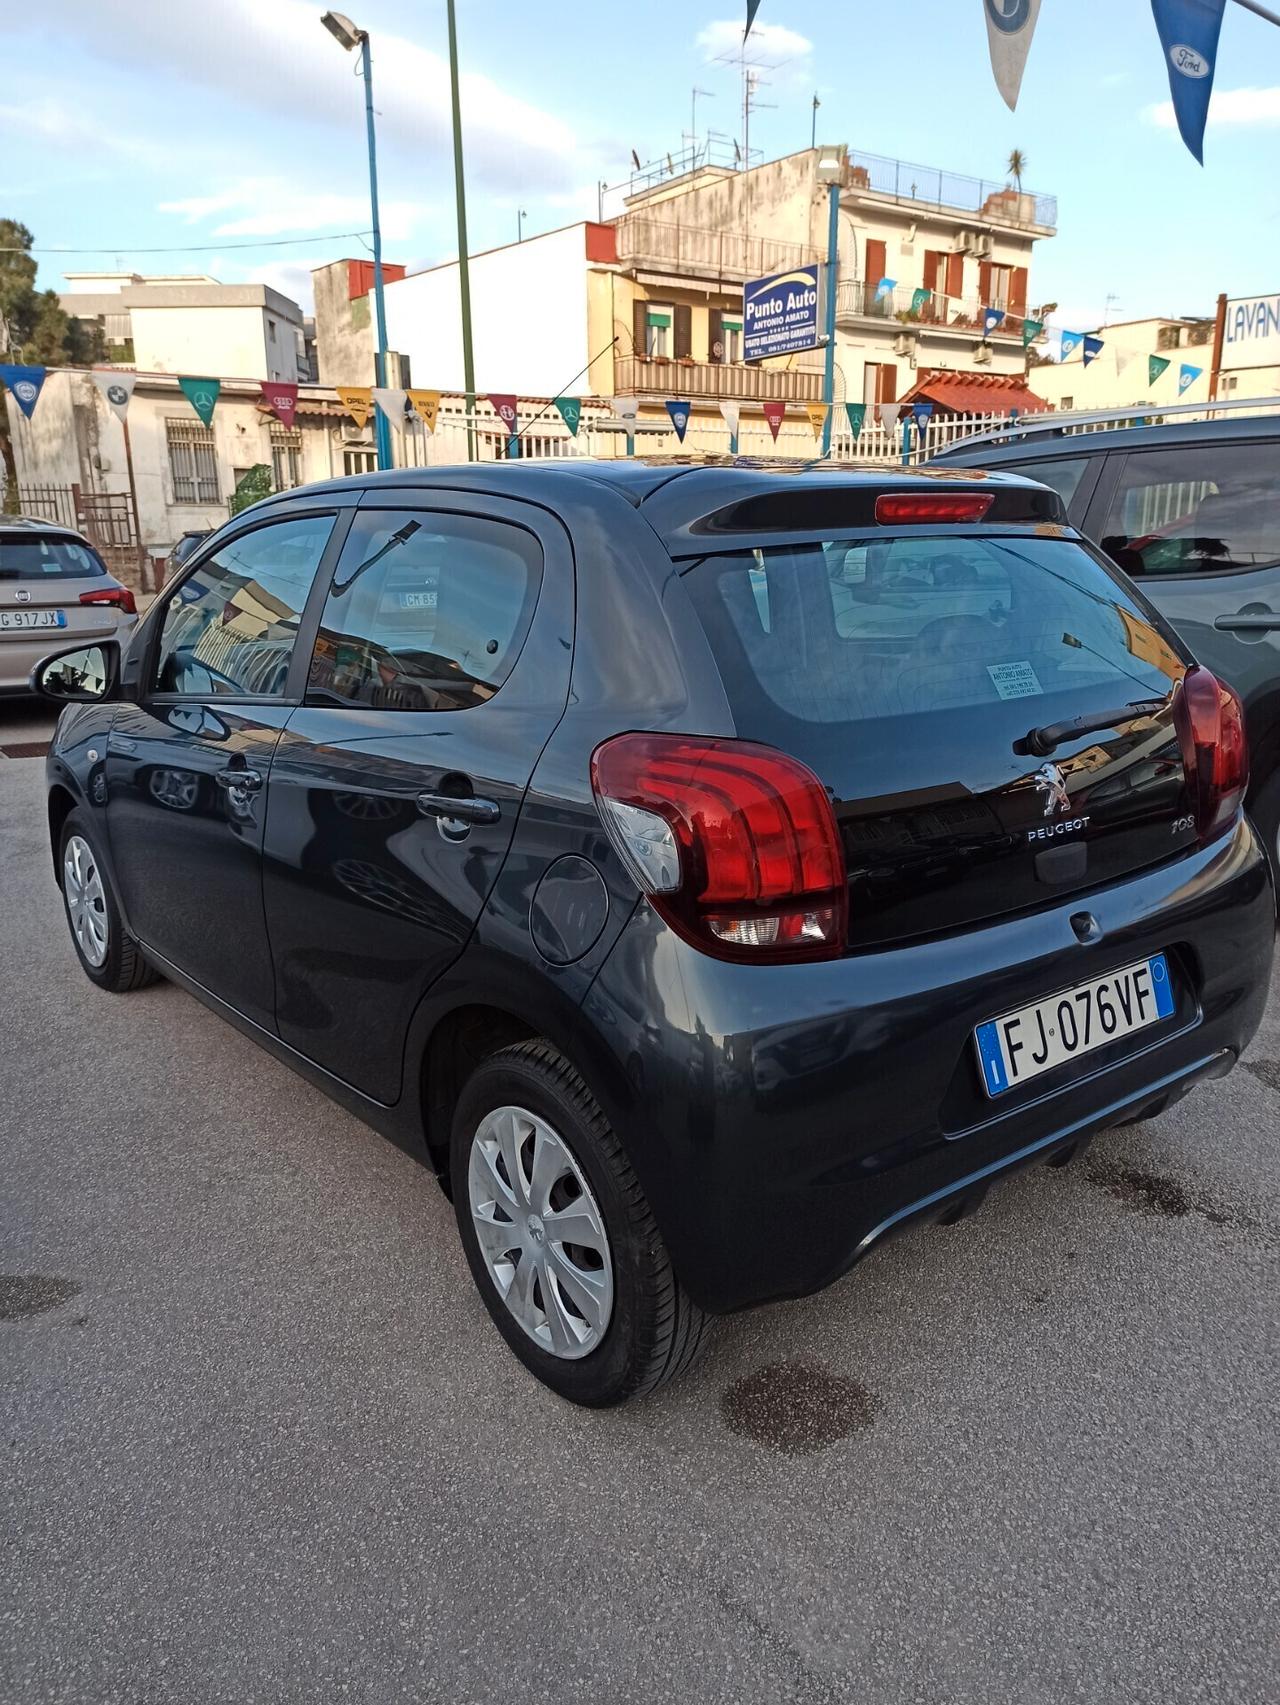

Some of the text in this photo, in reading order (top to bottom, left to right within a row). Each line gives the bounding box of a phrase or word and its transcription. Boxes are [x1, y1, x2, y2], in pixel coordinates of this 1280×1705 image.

[1177, 48, 1201, 73] Ford
[746, 289, 816, 320] Punto Auto
[753, 310, 809, 331] ANTONIO AMATO
[346, 397, 367, 405] OPEL
[1028, 816, 1091, 842] PEUGEOT
